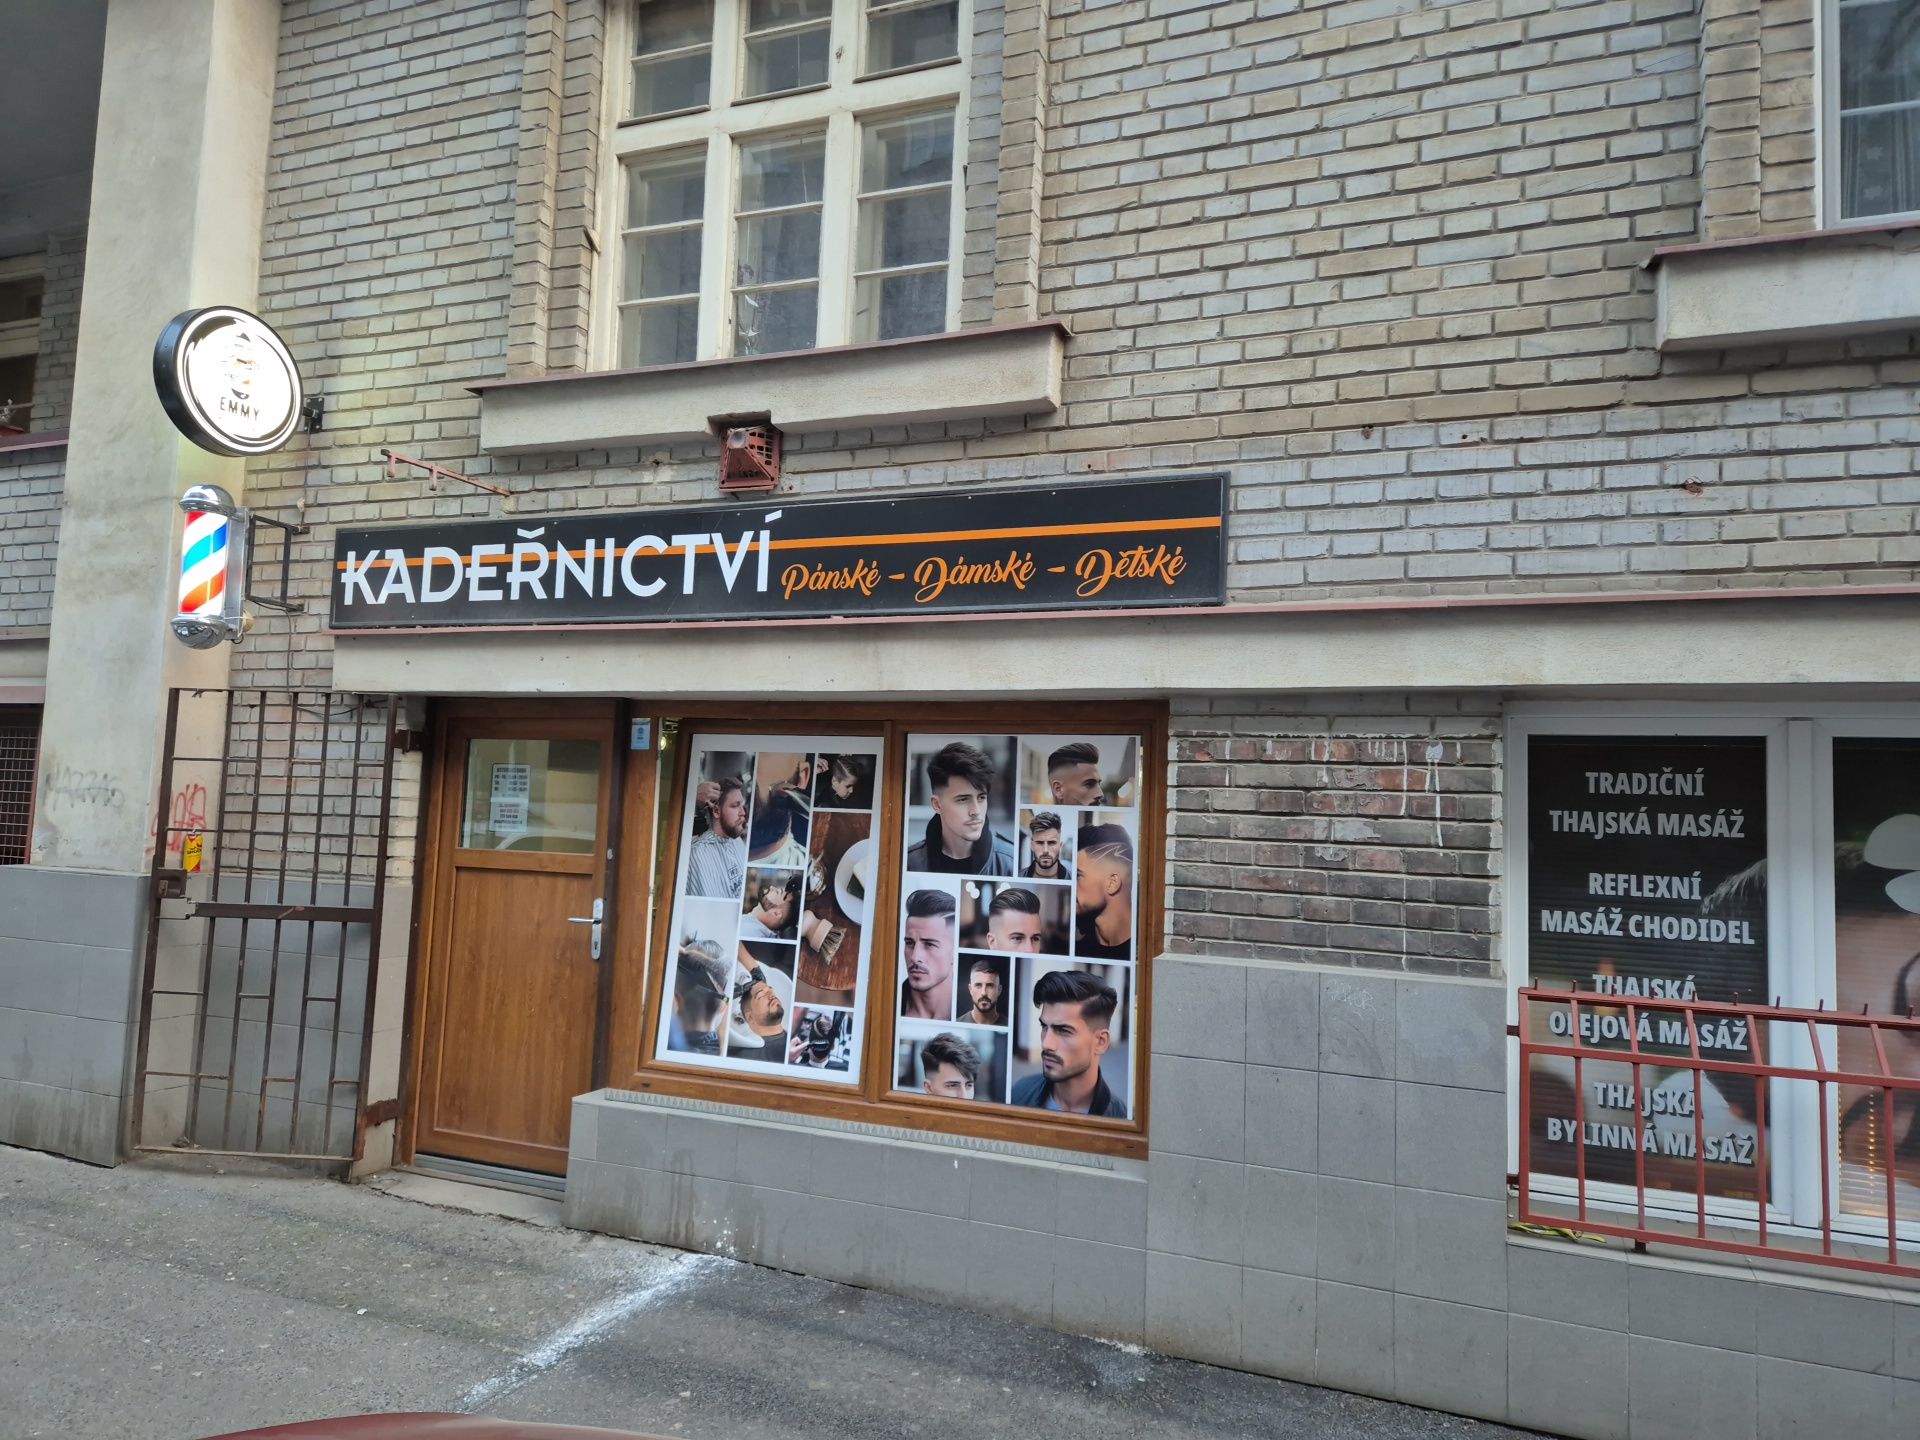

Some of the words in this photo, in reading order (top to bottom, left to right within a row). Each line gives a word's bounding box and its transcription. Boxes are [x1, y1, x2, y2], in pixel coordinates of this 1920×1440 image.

[220, 396, 259, 421] EMMY
[341, 510, 782, 605] KADEŘNICTVÍ
[781, 558, 881, 600] Pánské
[913, 551, 1036, 603] Dámské
[1075, 544, 1188, 598] Dětské
[1585, 767, 1704, 796] TRADIČNÍ
[1549, 807, 1651, 839] THAJSKÁ
[1657, 809, 1745, 838] MASÁŽ
[1588, 871, 1702, 900] REFLEXNÍ
[1541, 907, 1624, 936] MASÁŽ
[1628, 914, 1756, 945] CHODIDEL
